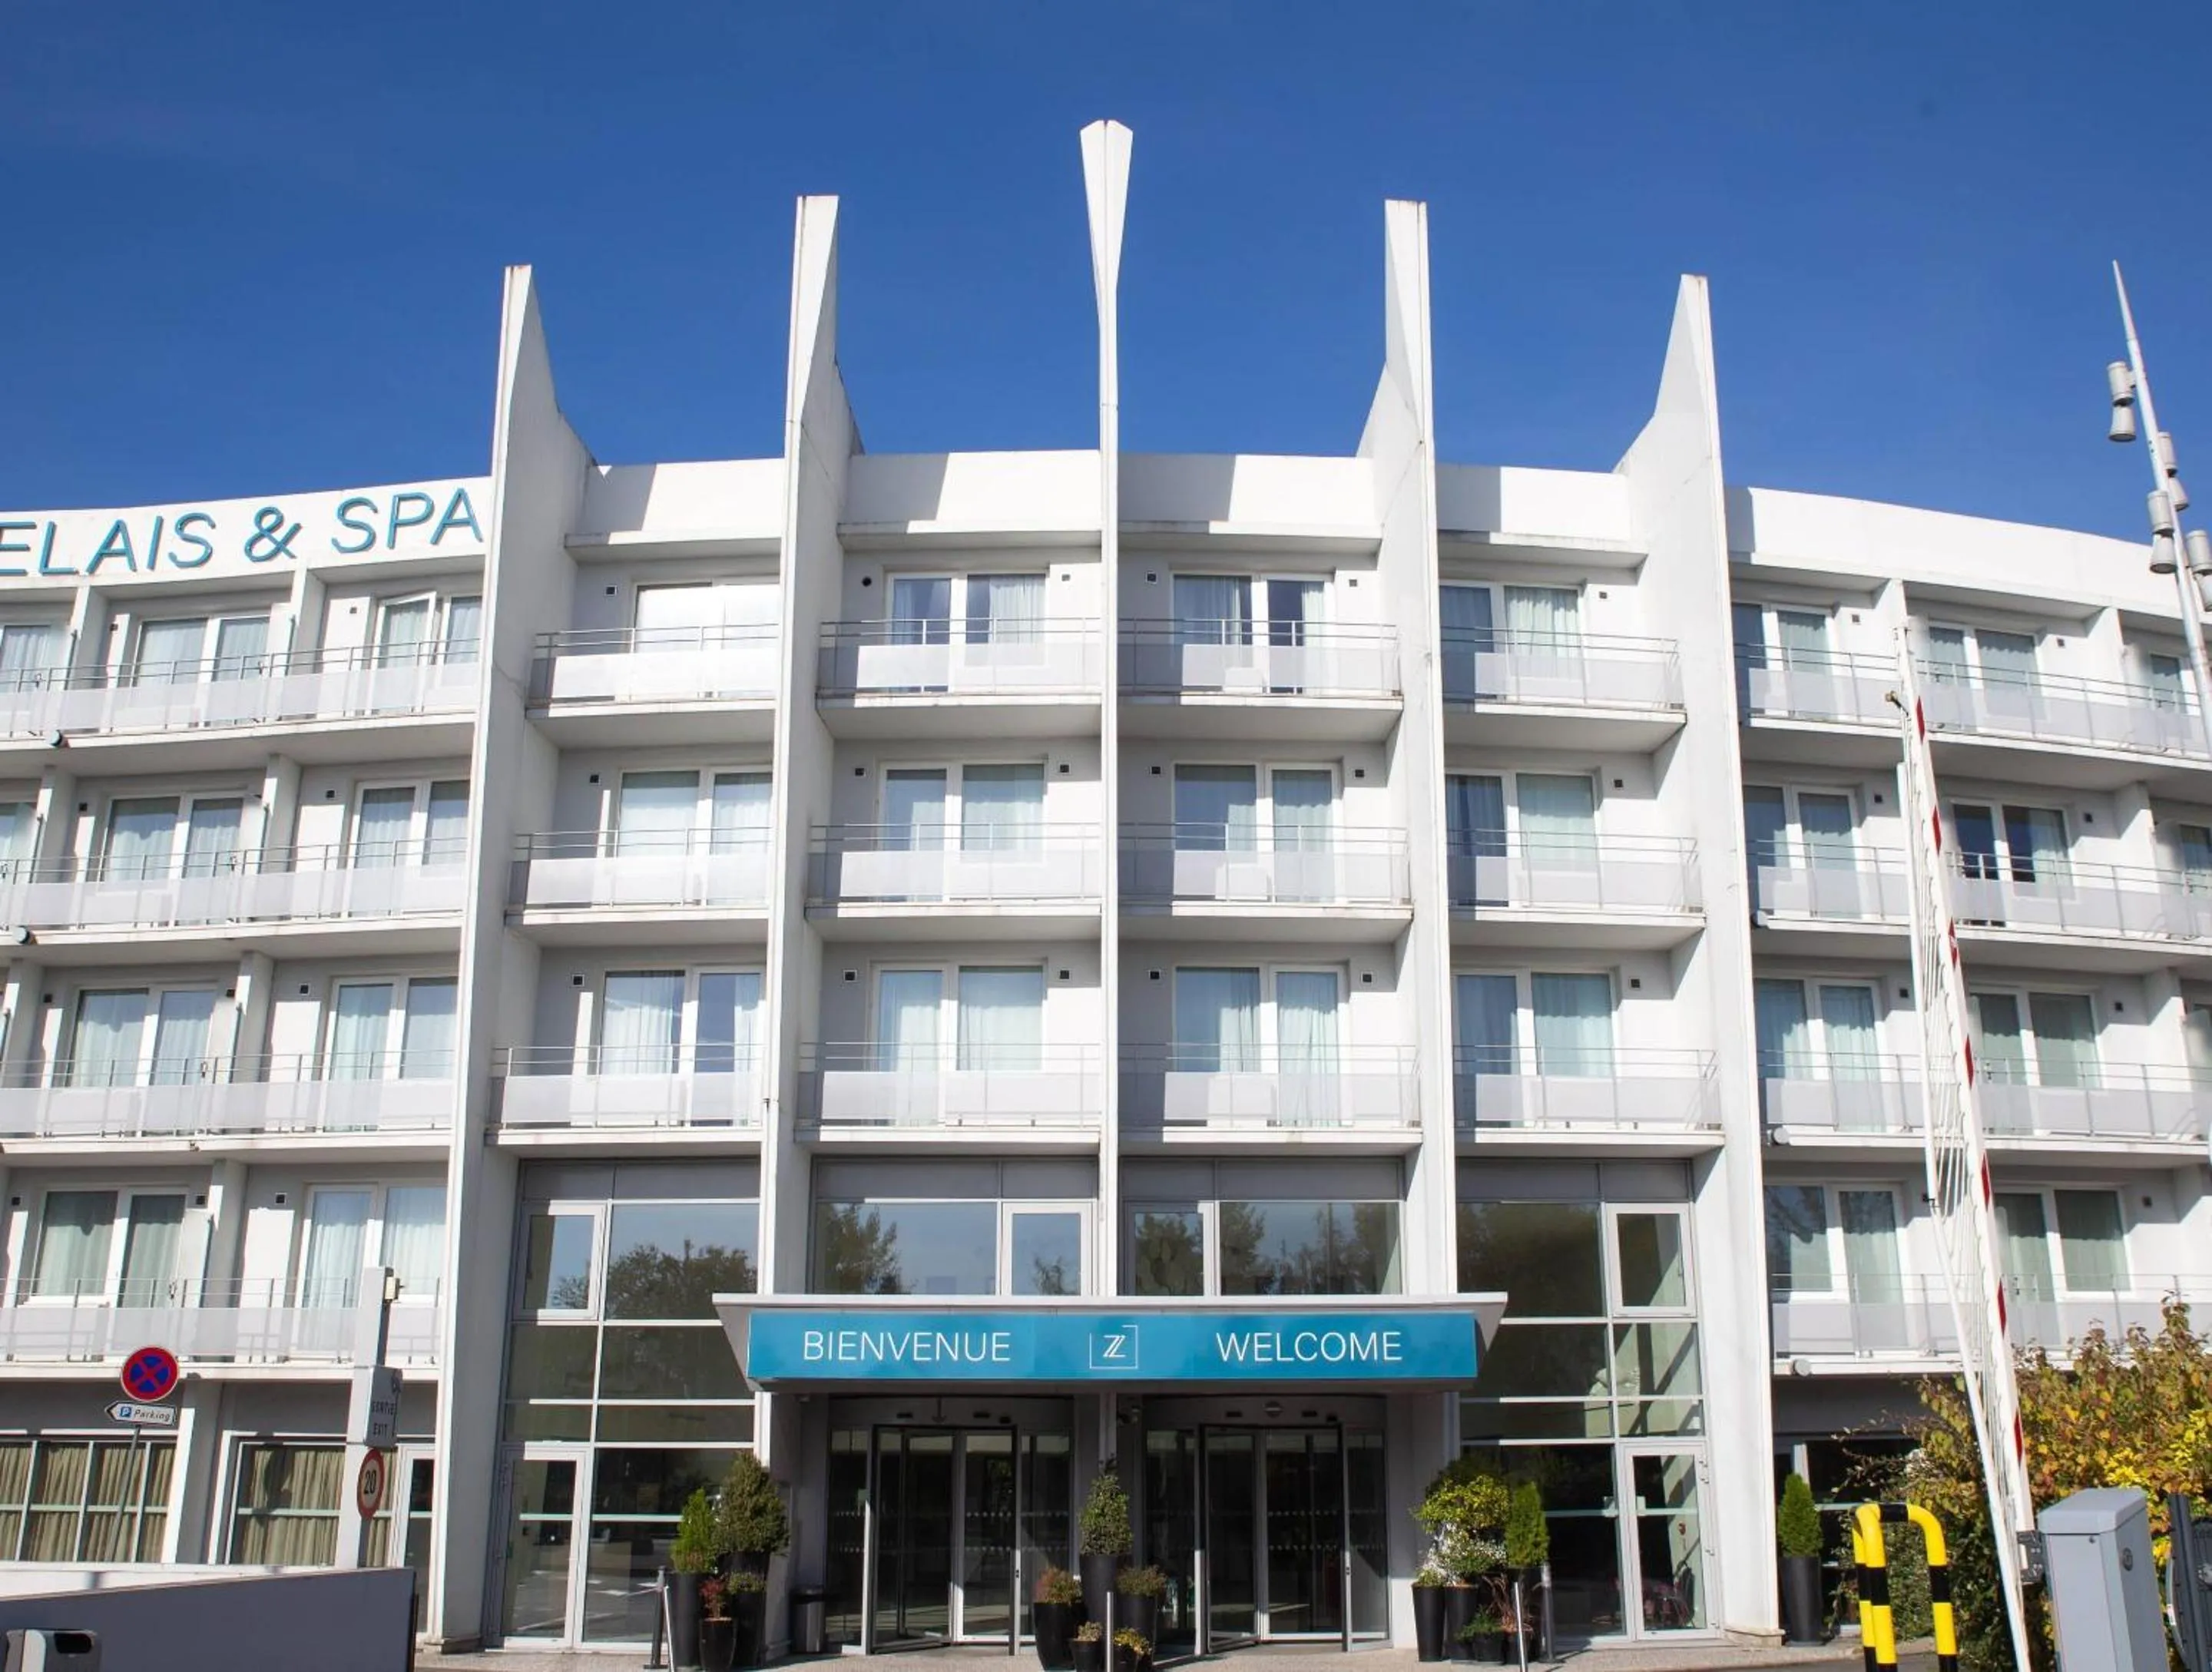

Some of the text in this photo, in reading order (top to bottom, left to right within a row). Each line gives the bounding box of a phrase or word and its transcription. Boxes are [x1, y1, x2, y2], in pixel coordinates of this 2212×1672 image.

[243, 505, 303, 563] &
[331, 488, 483, 553] SPA
[803, 1331, 1011, 1362] BIENVENUE
[1216, 1331, 1403, 1362] WELCOME
[134, 1409, 171, 1422] Parking
[364, 1469, 376, 1495] 20
